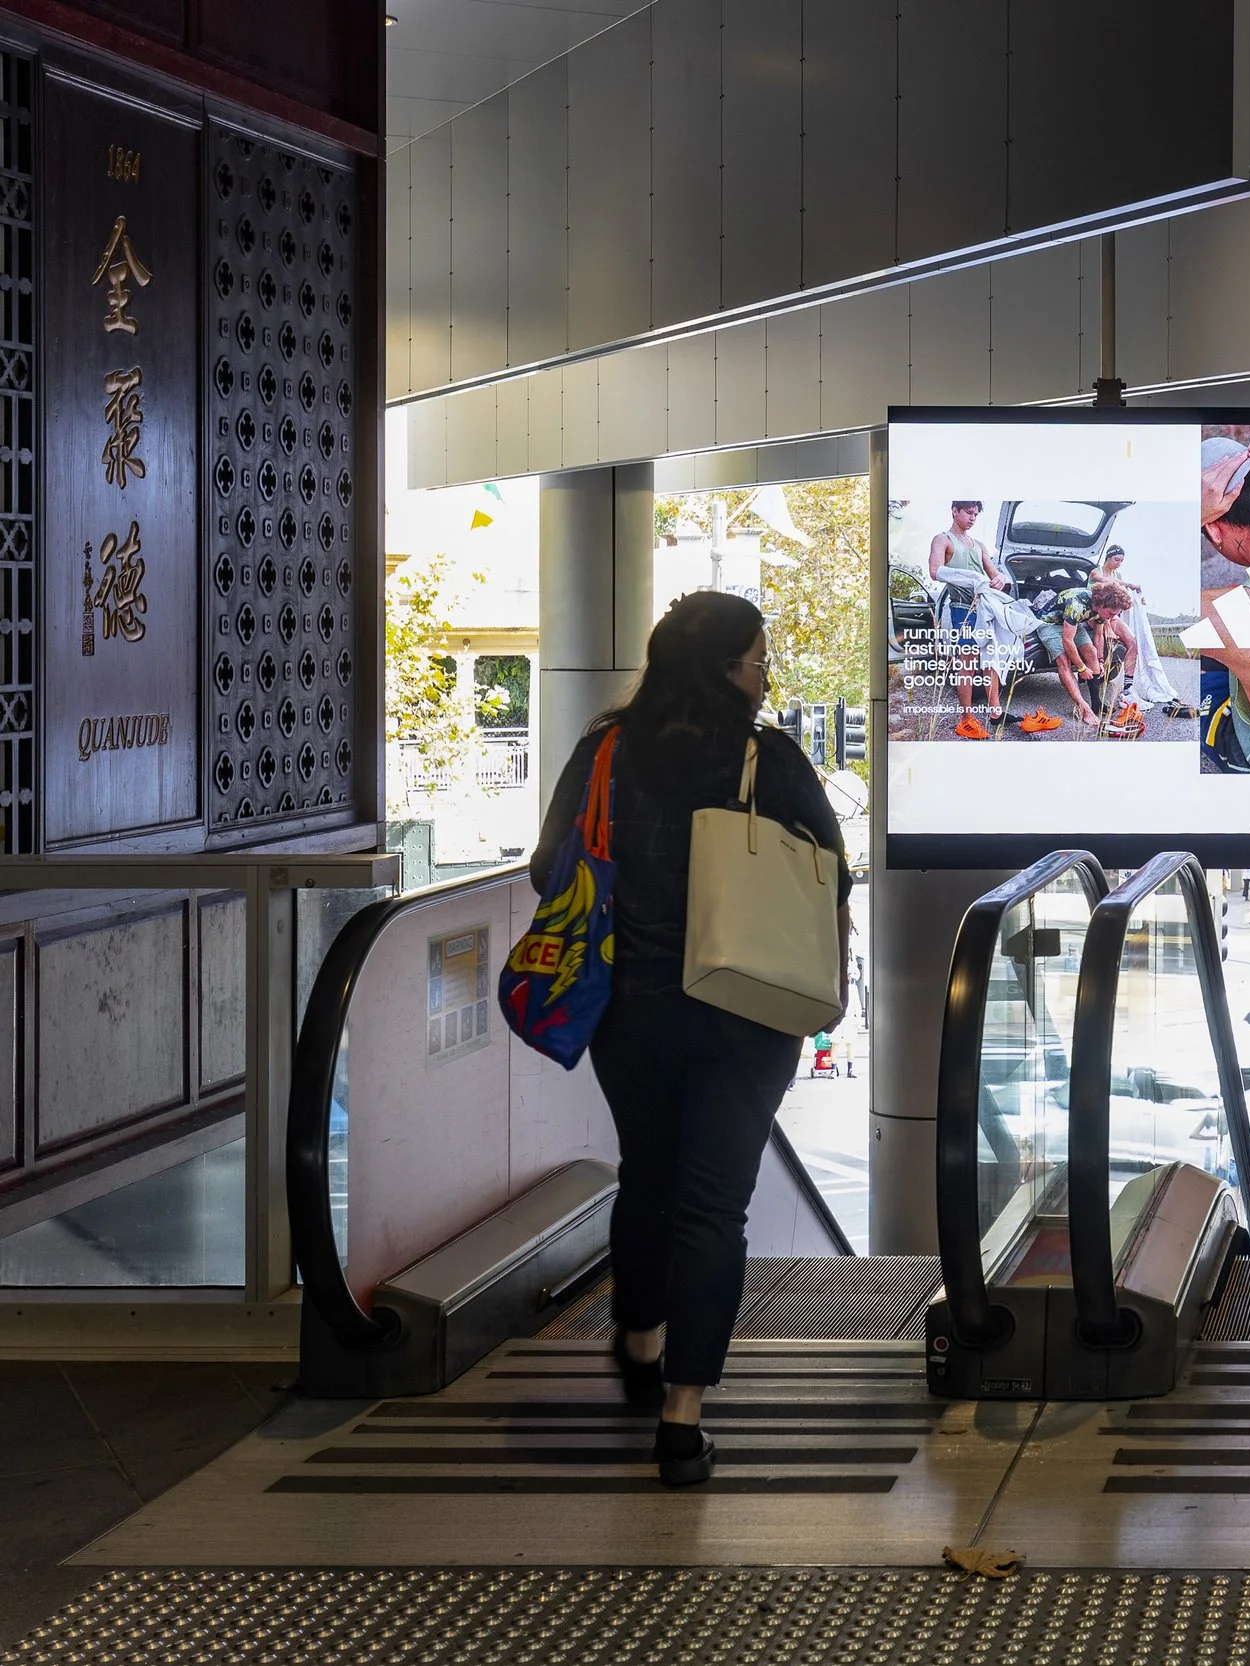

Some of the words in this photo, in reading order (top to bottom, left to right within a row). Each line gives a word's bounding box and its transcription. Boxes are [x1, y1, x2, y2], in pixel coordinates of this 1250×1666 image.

[107, 144, 142, 185] 1864
[904, 627, 959, 643] running
[962, 626, 994, 640] likes
[904, 642, 934, 655] fast
[938, 641, 983, 657] times,
[986, 641, 1020, 655] slow
[952, 657, 979, 671] but
[980, 657, 1036, 673] mostly,
[904, 673, 945, 690] good
[948, 673, 992, 687] times
[903, 704, 954, 715] impossible
[956, 704, 965, 714] is
[965, 704, 1003, 716] nothing
[78, 712, 170, 762] QUANJUDE
[519, 941, 561, 967] ICE
